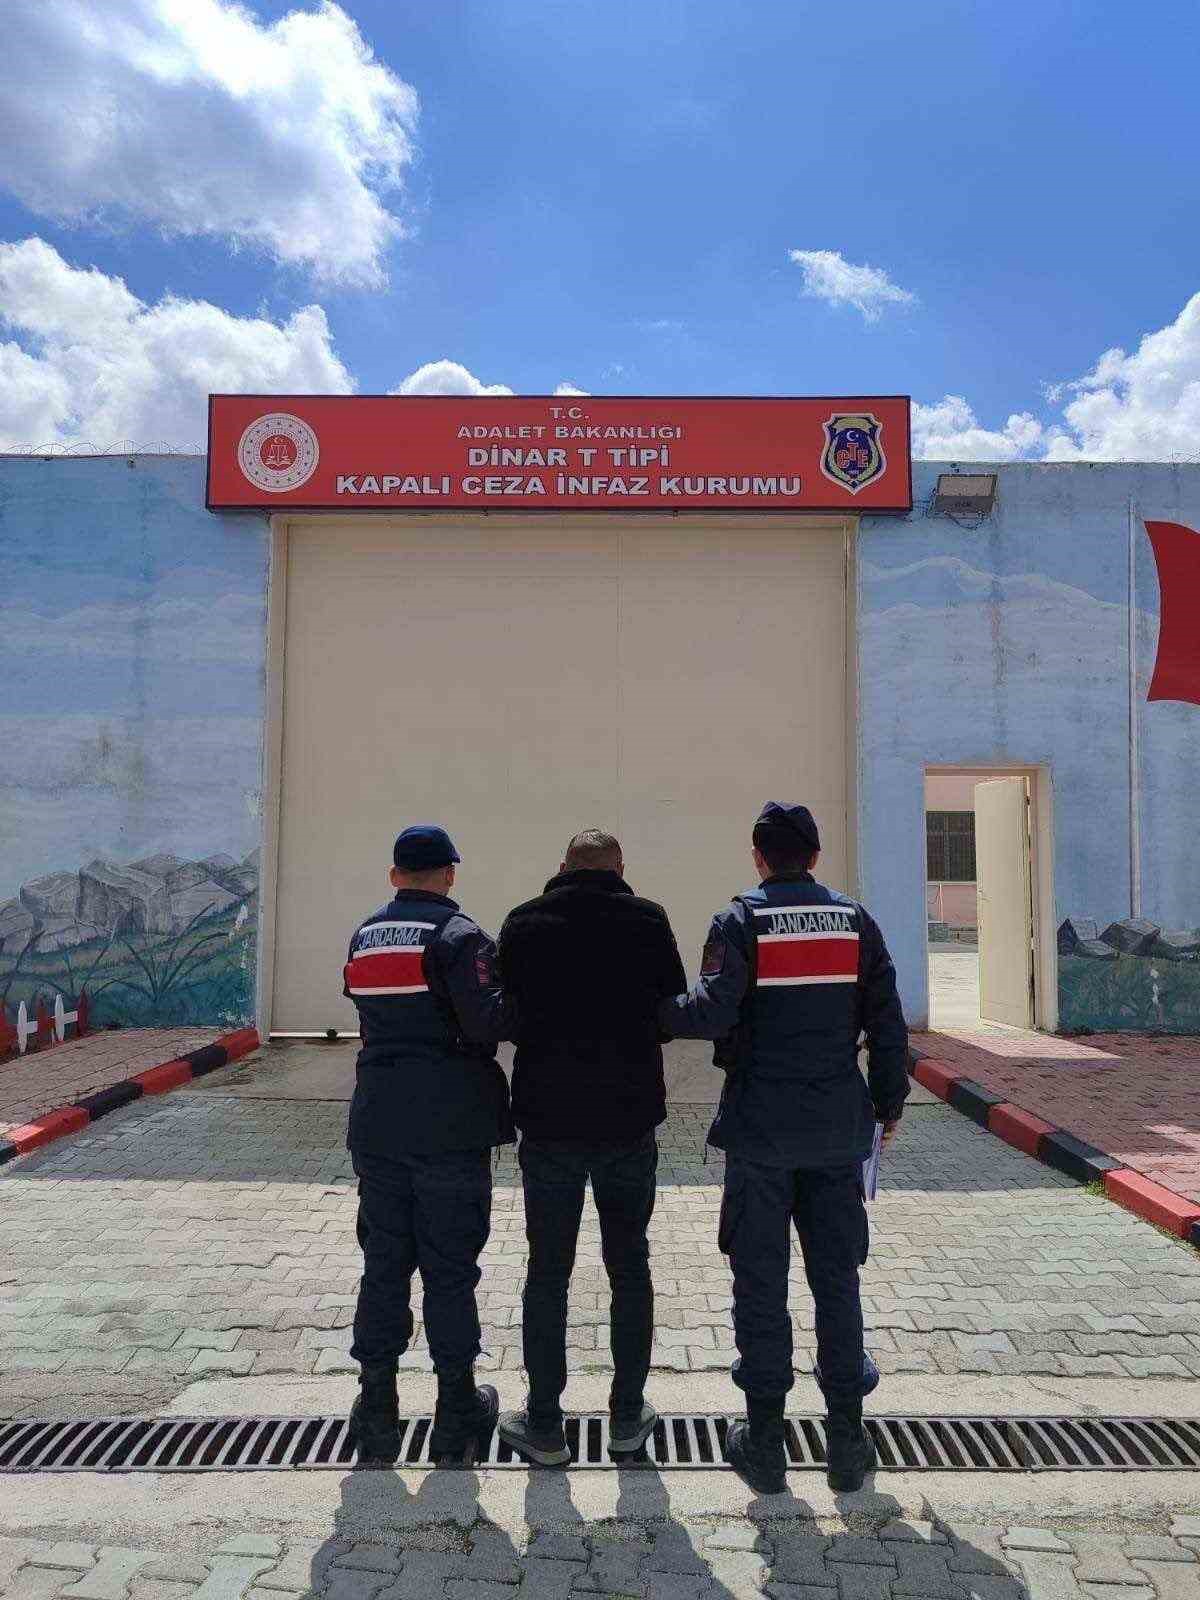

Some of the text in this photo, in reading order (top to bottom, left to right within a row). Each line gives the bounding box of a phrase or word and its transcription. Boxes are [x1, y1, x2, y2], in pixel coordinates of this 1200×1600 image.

[550, 407, 590, 419] T.C.
[457, 426, 546, 438] ADALET
[468, 444, 670, 466] DİNAR T TİPİ
[336, 473, 801, 495] KAPALI CEZA İNFAZ KURUMU
[767, 911, 851, 934] JANDARMA
[359, 928, 422, 949] JANDARMA
